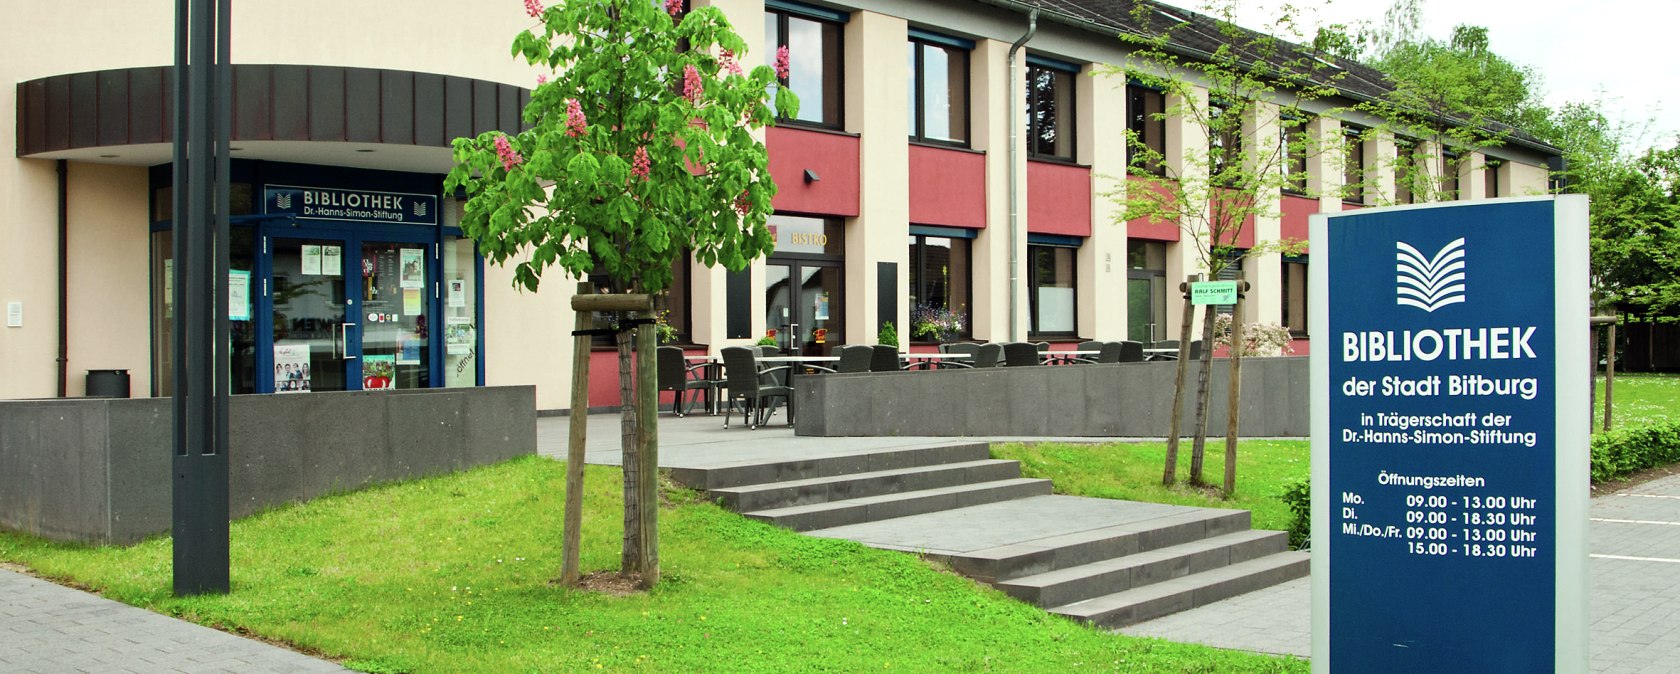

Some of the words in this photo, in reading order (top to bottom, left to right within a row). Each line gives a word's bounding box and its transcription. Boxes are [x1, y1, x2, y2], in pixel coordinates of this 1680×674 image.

[304, 190, 403, 210] BIBLIOTHEK
[304, 206, 403, 221] Dr.-Hanns-Simon-Stiftung
[791, 232, 828, 247] BISTRO
[1343, 326, 1537, 362] BIBLIOTHEK
[1342, 376, 1377, 397] der
[1381, 375, 1442, 397] Stadt
[1448, 374, 1538, 400] Bitburg
[1361, 412, 1374, 427] in
[1377, 412, 1477, 430] Trägerschaft
[1481, 412, 1512, 427] der
[1342, 428, 1537, 447] Dr.-Hanns-Simon-Stiftung
[1378, 470, 1485, 490] Öffnungszeiten
[1342, 492, 1365, 505] Mo.
[1406, 495, 1448, 508] 09.00
[1463, 496, 1506, 509] 13.00
[1510, 496, 1537, 509] Uhr
[1342, 507, 1358, 520] Di.
[1406, 510, 1448, 524] 09.00
[1463, 512, 1506, 525] 18.30
[1510, 512, 1537, 526] Uhr
[1342, 522, 1402, 539] Mi./Do./Fr.
[1406, 526, 1448, 540] 09.00
[1463, 528, 1506, 541] 13.00
[1510, 528, 1537, 542] Uhr
[1408, 541, 1448, 556] 15.00
[1463, 543, 1506, 557] 18.30
[1511, 543, 1537, 558] Uhr
